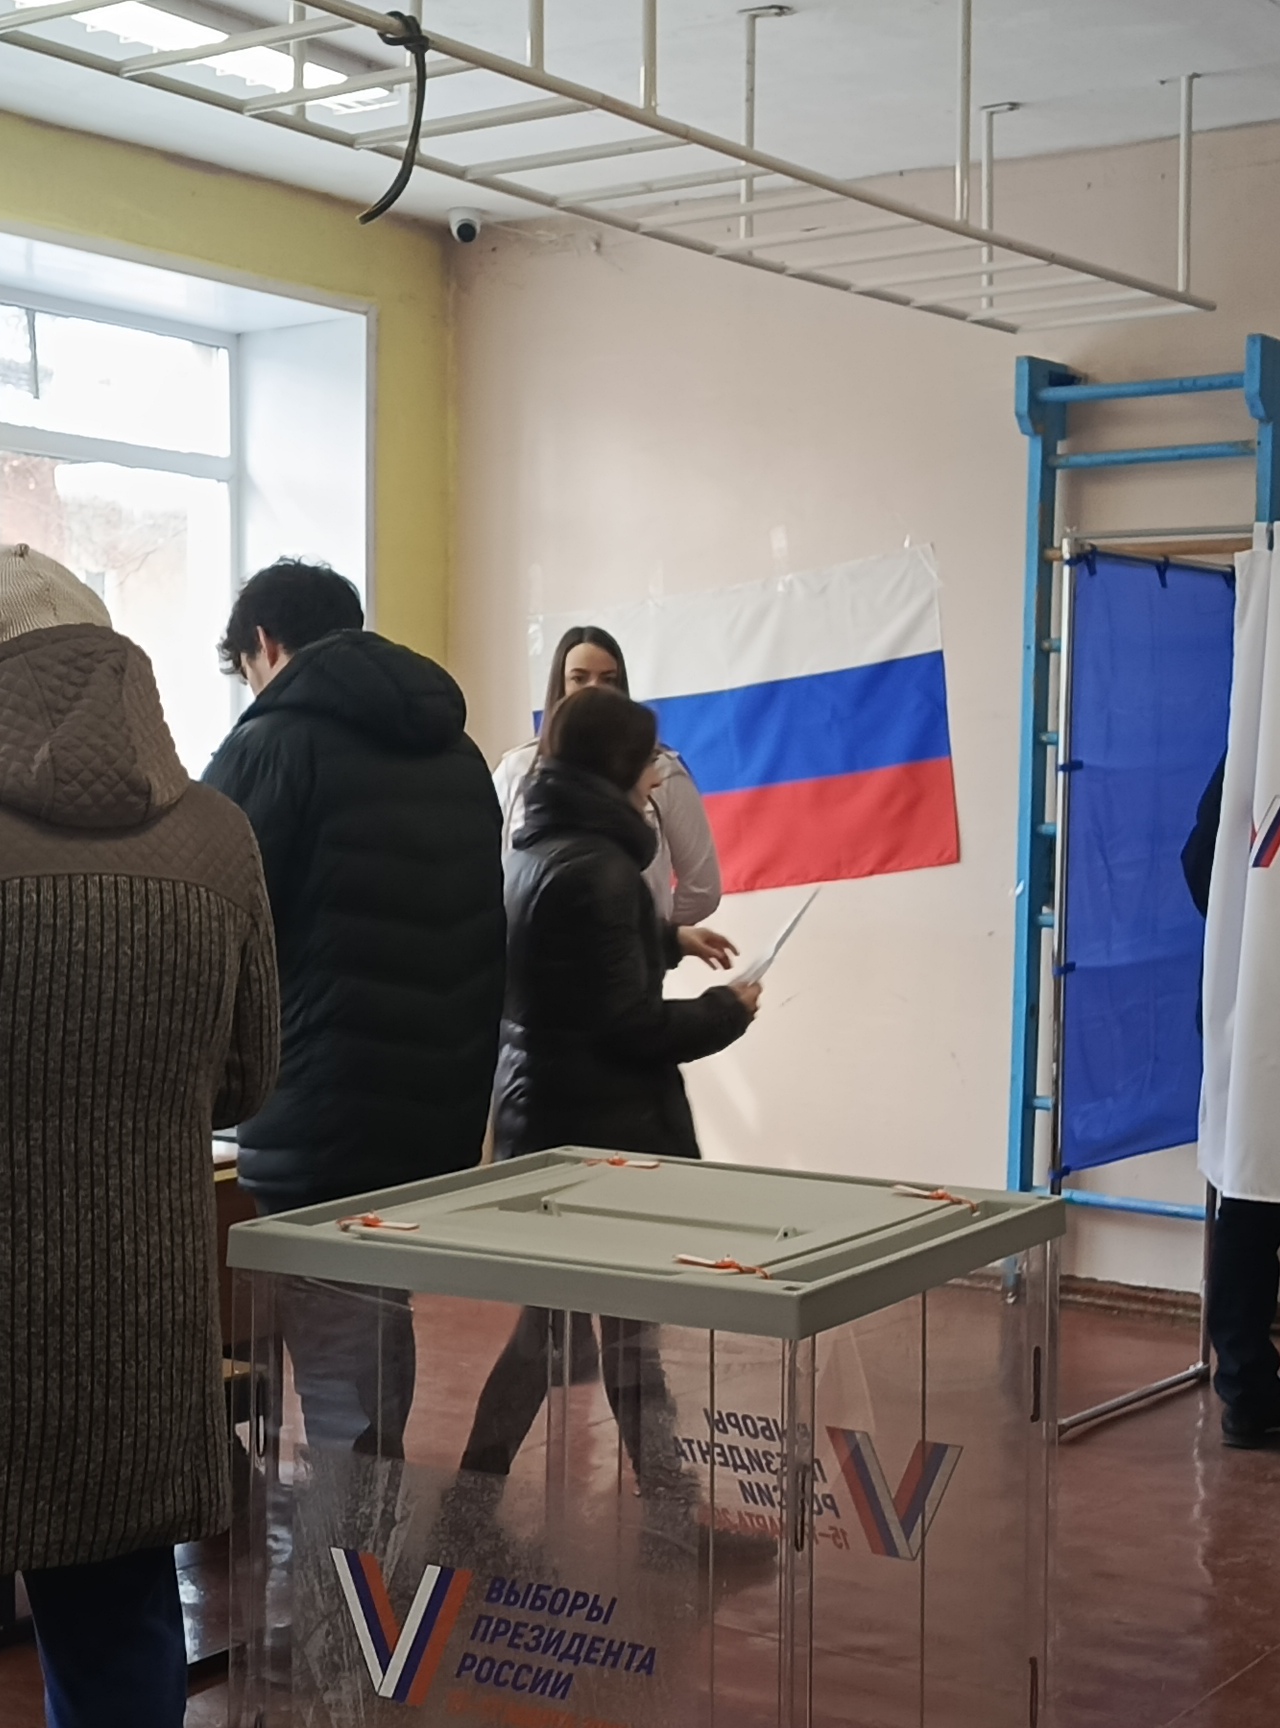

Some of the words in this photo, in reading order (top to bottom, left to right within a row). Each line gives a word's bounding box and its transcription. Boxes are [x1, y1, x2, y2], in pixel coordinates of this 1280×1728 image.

[484, 1576, 618, 1626] ВЫБОРЫ
[469, 1614, 657, 1676] ПРЕЗИДЕНТА
[455, 1652, 575, 1700] РОССИИ
